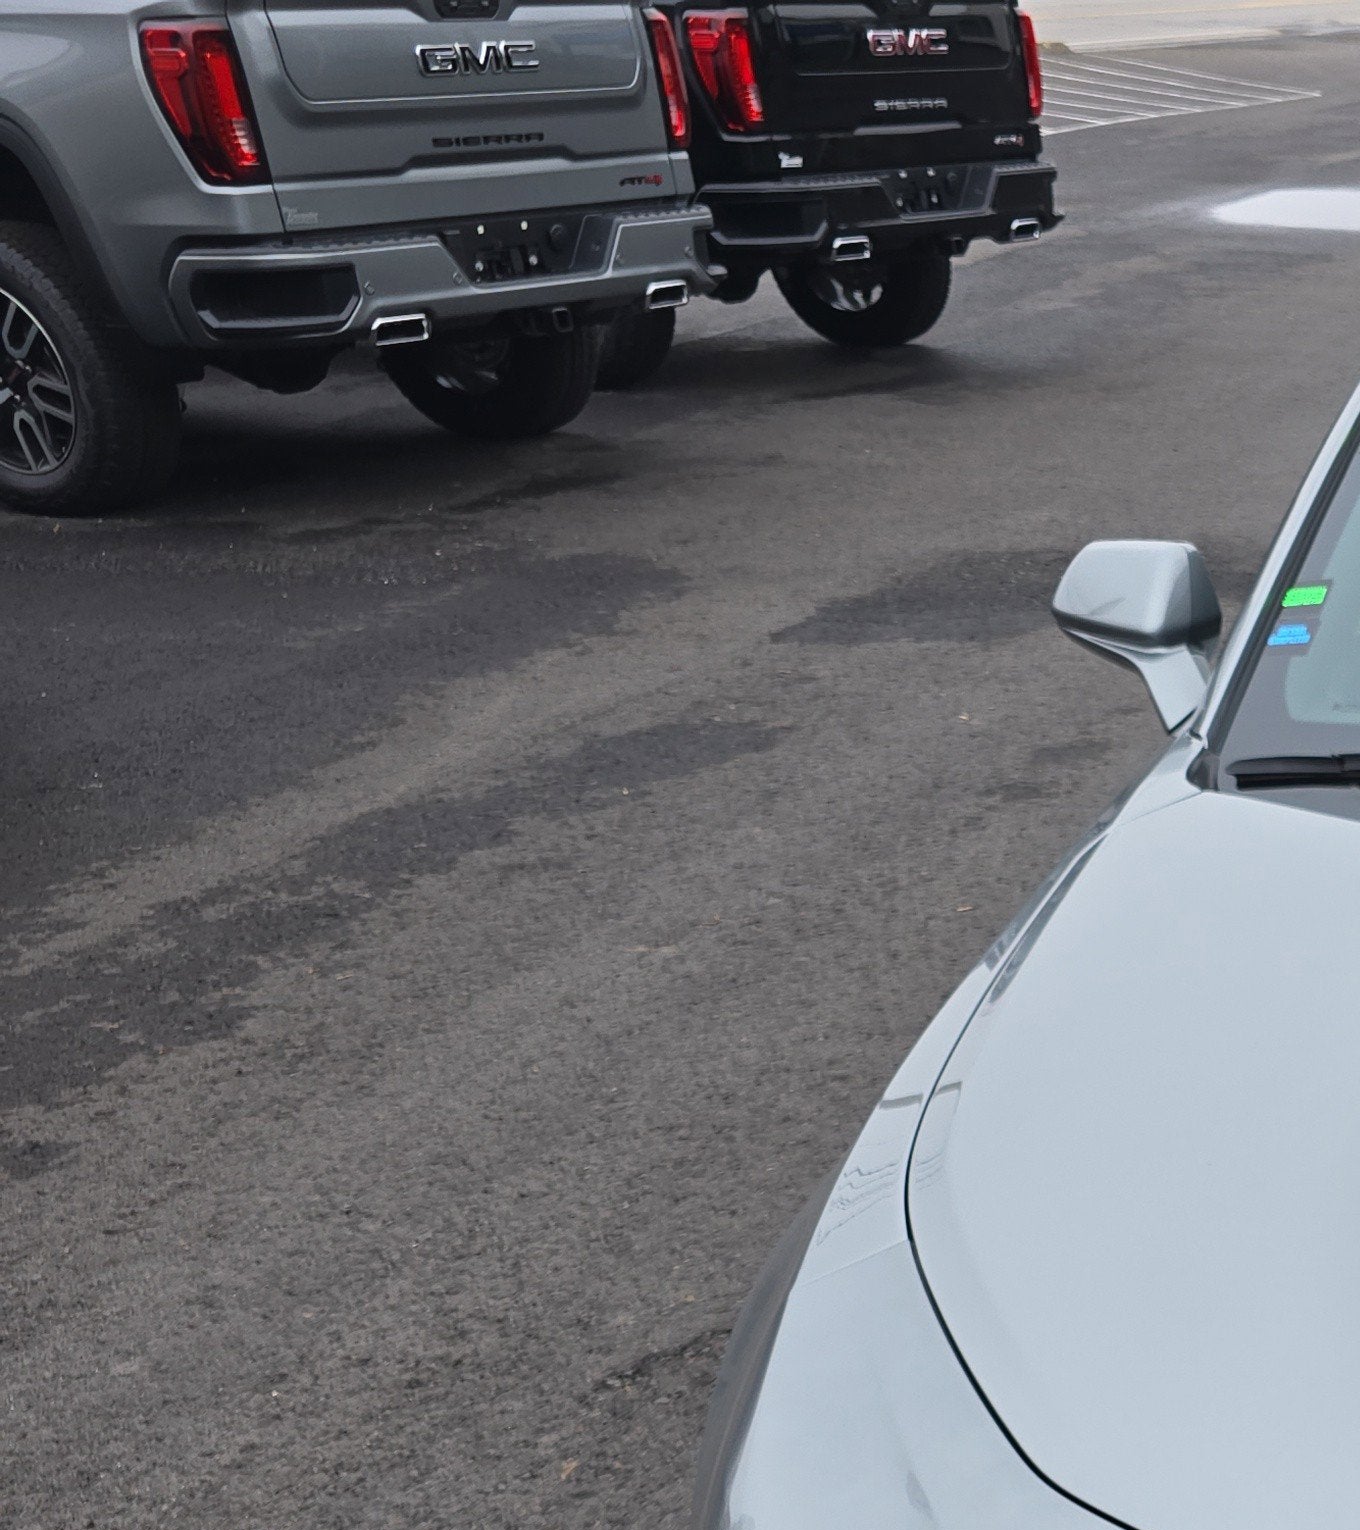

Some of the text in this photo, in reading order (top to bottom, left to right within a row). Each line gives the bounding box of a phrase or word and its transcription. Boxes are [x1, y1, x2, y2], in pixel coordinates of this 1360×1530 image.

[866, 28, 949, 57] GMC
[416, 40, 540, 77] GMC
[874, 98, 948, 111] SIERRA
[432, 132, 544, 147] SIERRA
